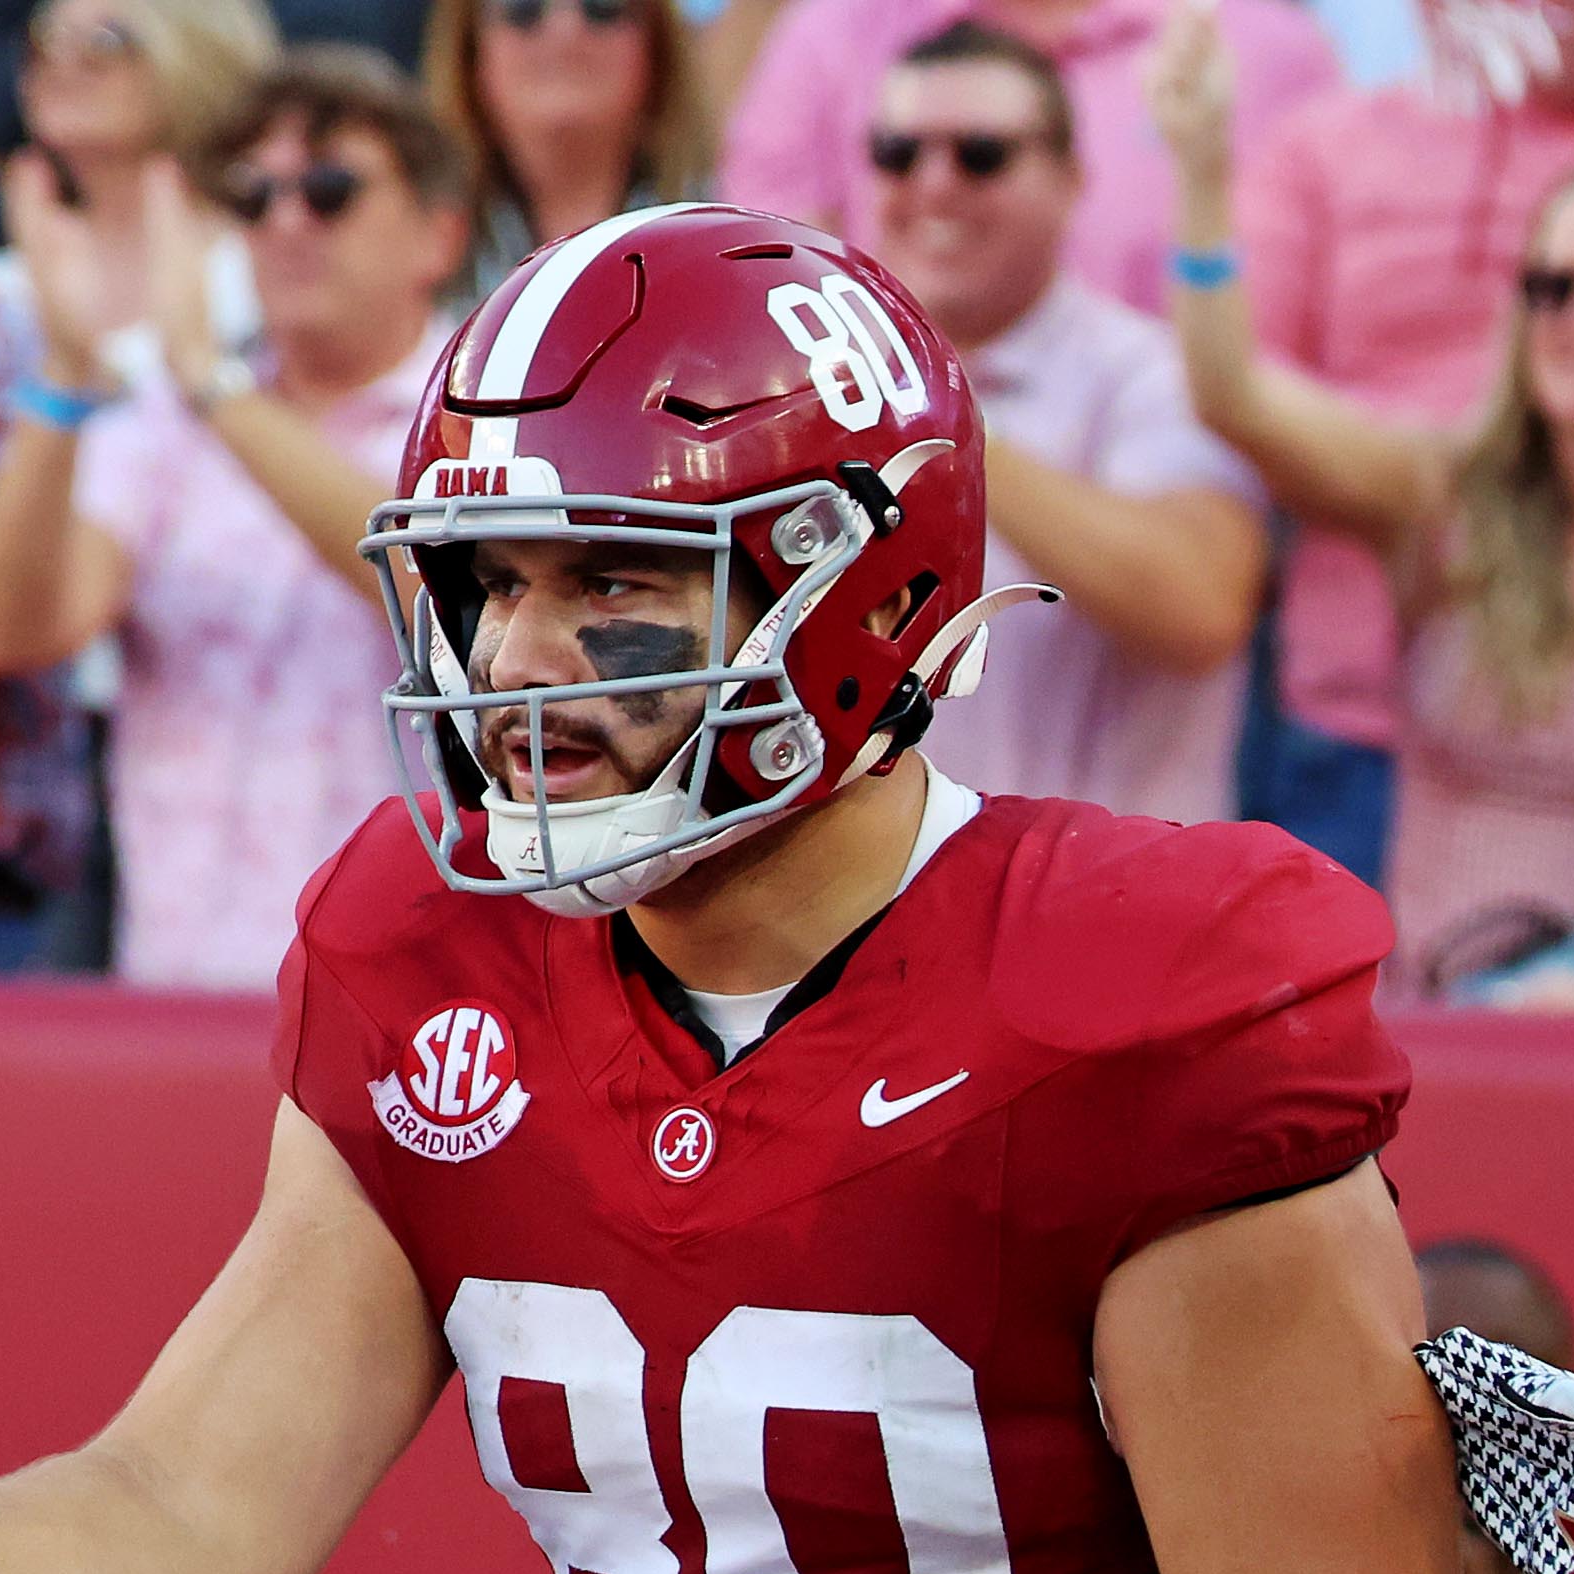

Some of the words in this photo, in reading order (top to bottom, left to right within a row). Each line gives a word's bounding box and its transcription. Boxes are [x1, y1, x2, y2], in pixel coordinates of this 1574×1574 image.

[768, 274, 930, 432] 80
[434, 466, 509, 498] BAMA
[409, 1007, 506, 1117] SEC
[386, 1104, 506, 1157] GRADUATE
